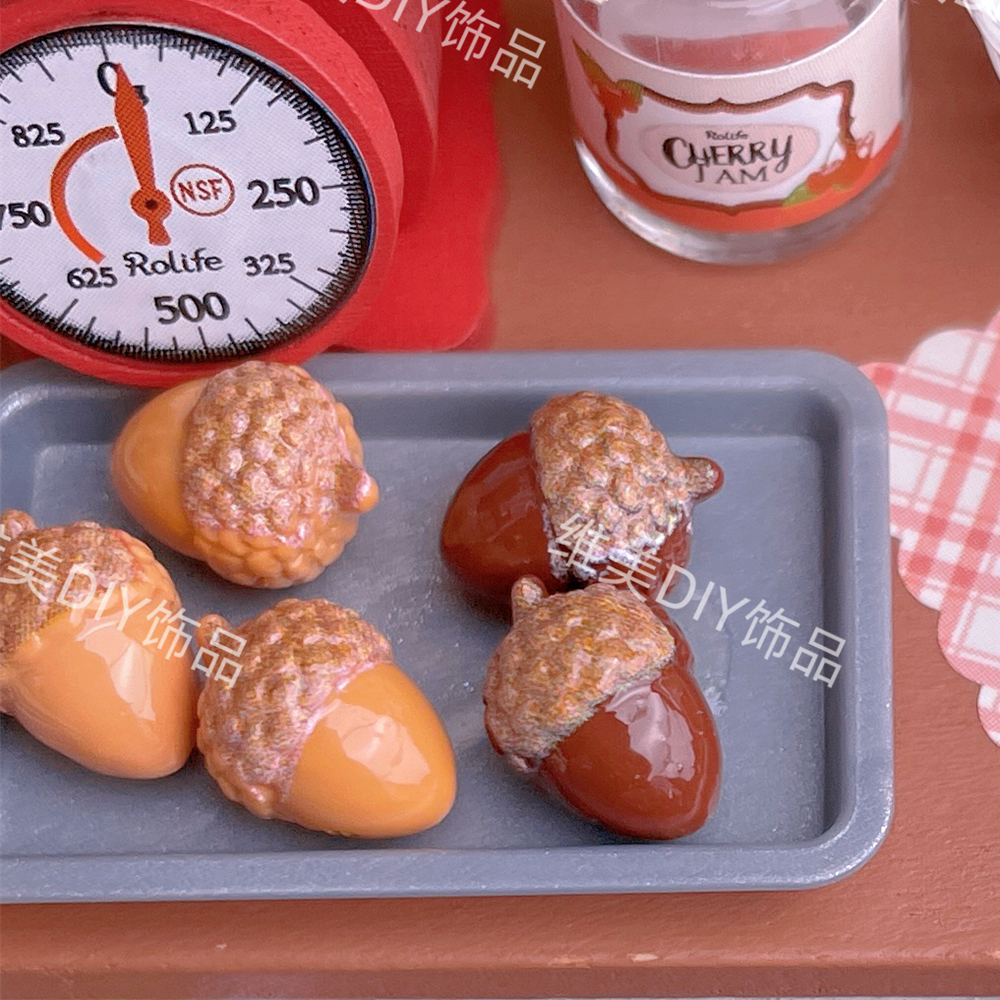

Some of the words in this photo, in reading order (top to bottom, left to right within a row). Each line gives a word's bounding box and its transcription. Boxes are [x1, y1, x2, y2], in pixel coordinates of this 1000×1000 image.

[11, 122, 65, 147] 825
[184, 110, 237, 136] 125
[662, 135, 793, 173] CHERRY
[176, 178, 223, 202] NSF
[247, 176, 320, 210] 250
[123, 248, 225, 277] Rolife
[244, 252, 296, 277] 325
[66, 266, 118, 289] 625
[154, 292, 231, 325] 500
